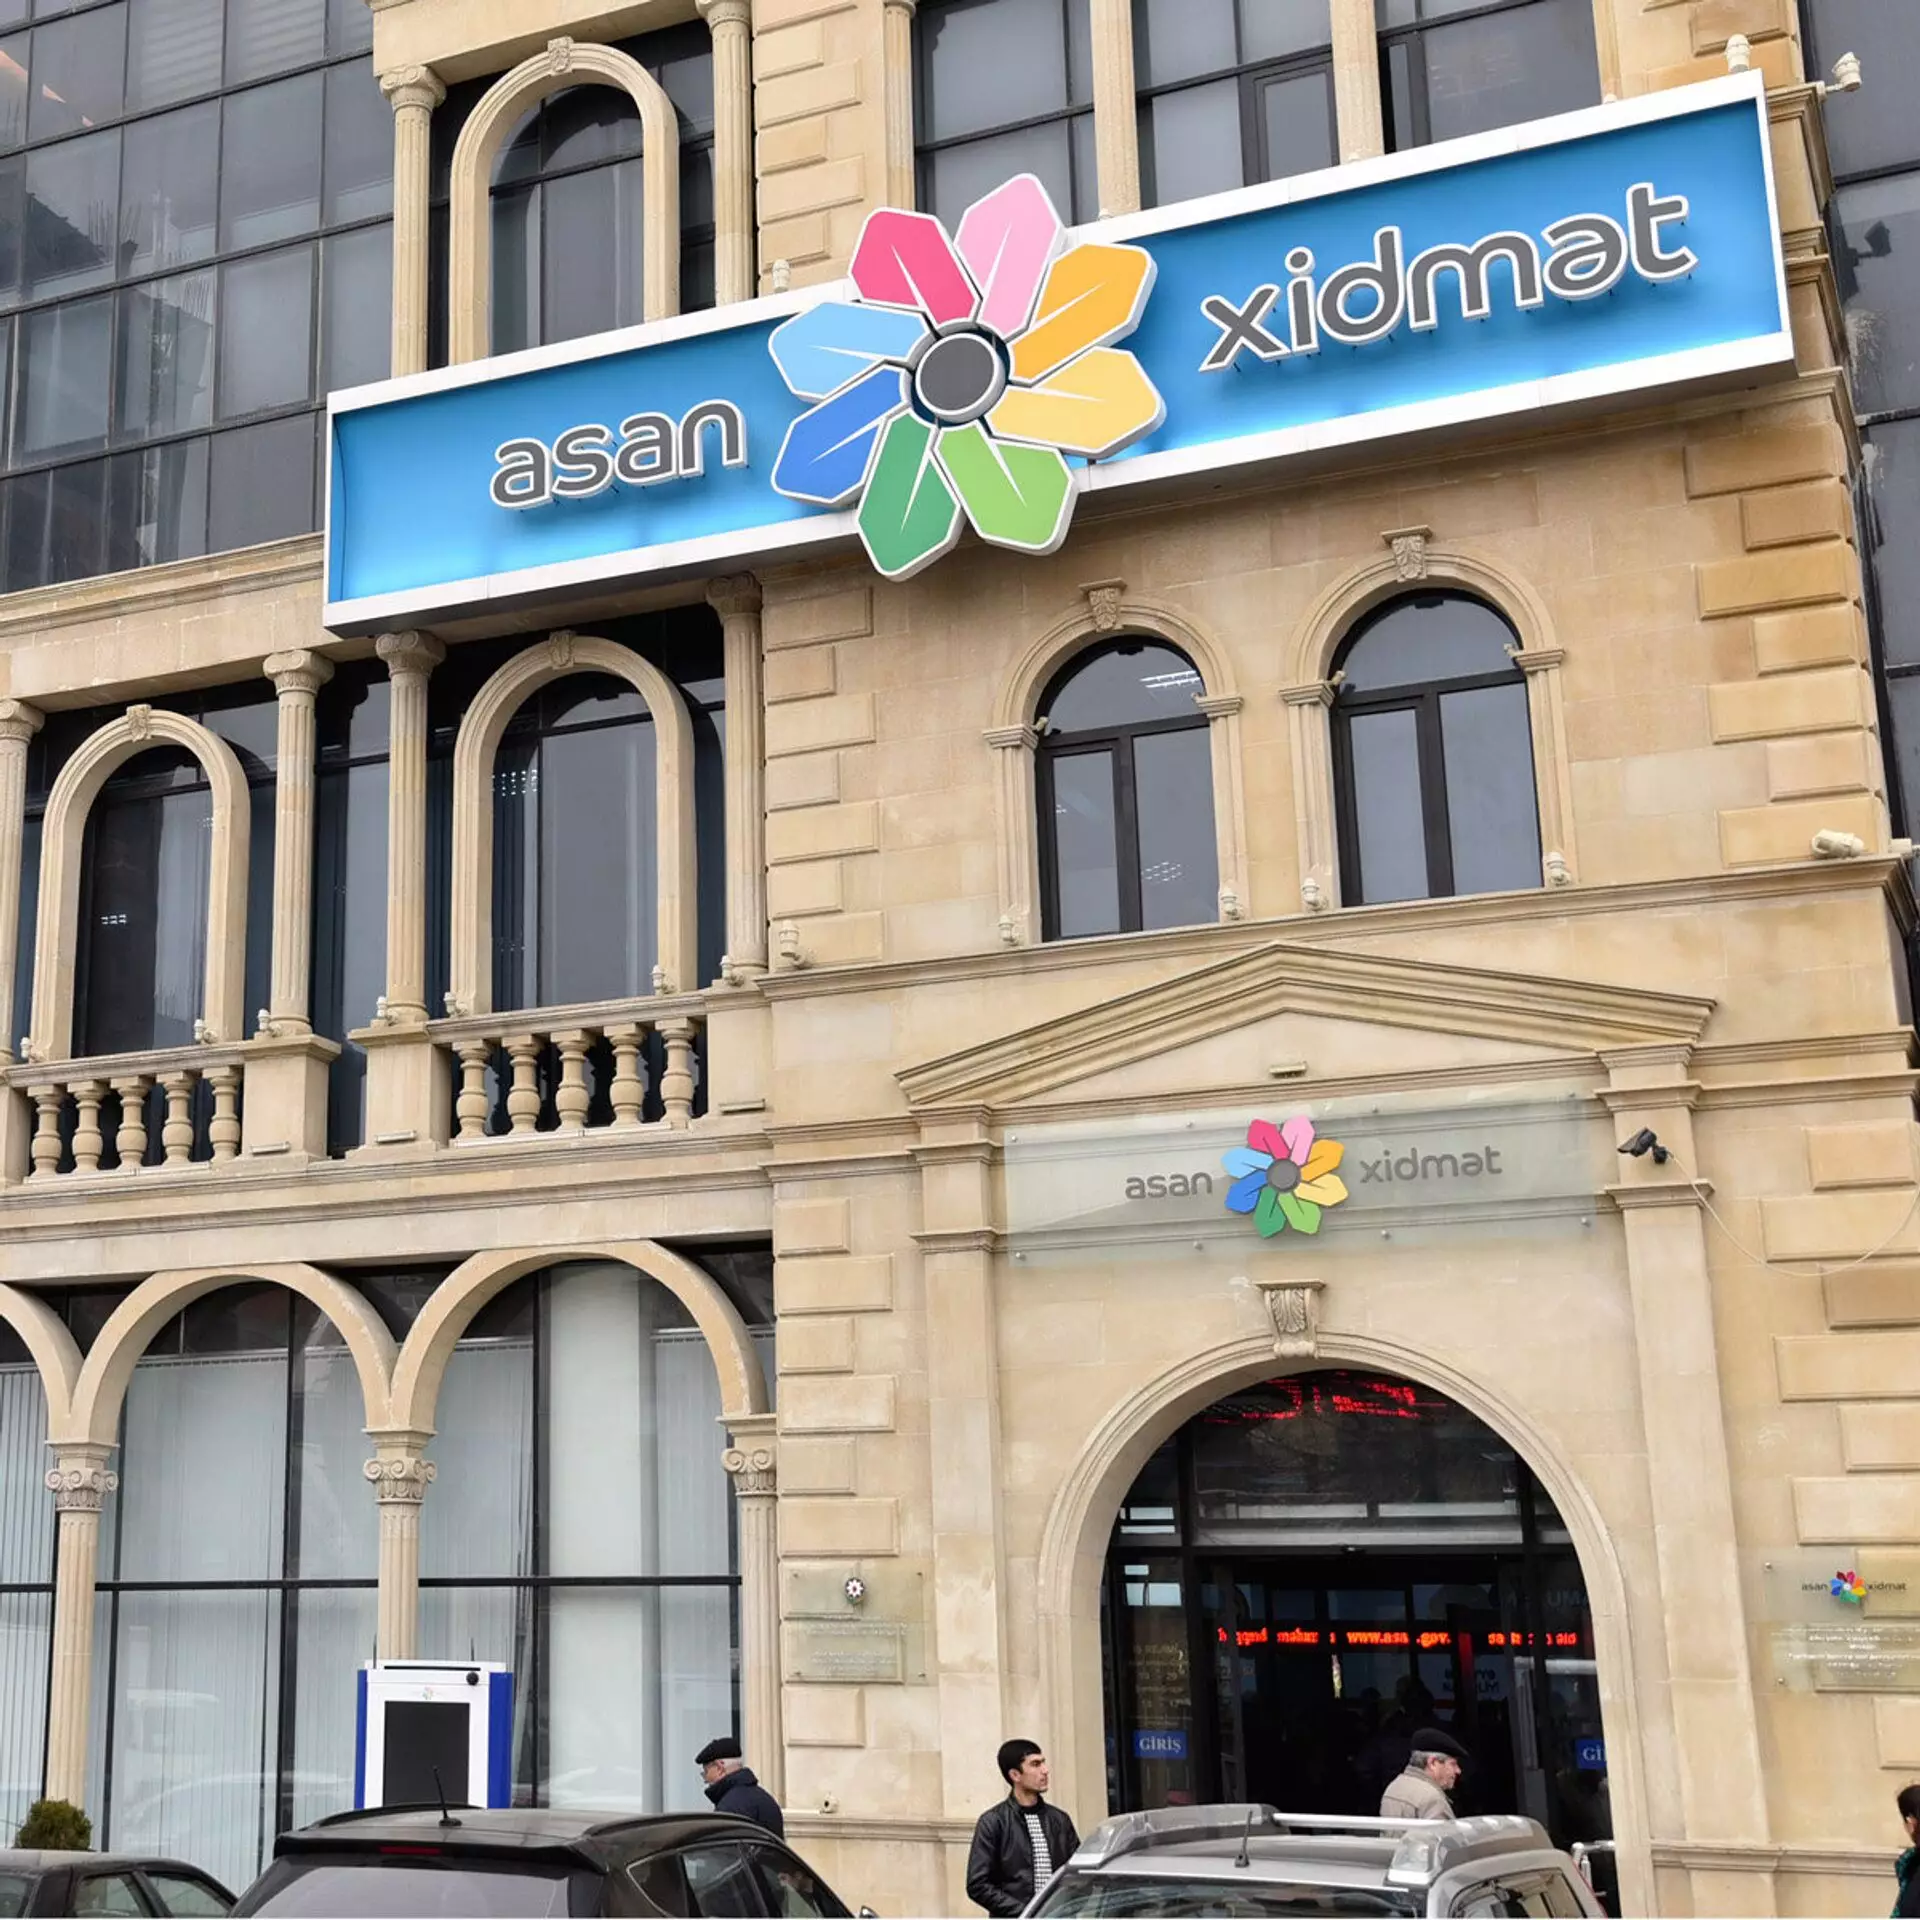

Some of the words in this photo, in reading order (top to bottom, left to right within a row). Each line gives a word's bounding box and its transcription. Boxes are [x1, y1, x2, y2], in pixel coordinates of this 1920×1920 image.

[490, 398, 747, 511] asan
[1199, 182, 1698, 372] xidmət
[1125, 1171, 1213, 1200] asan
[1359, 1145, 1503, 1184] xidmət
[1801, 1583, 1828, 1591] asan
[1139, 1736, 1182, 1753] GİRİŞ
